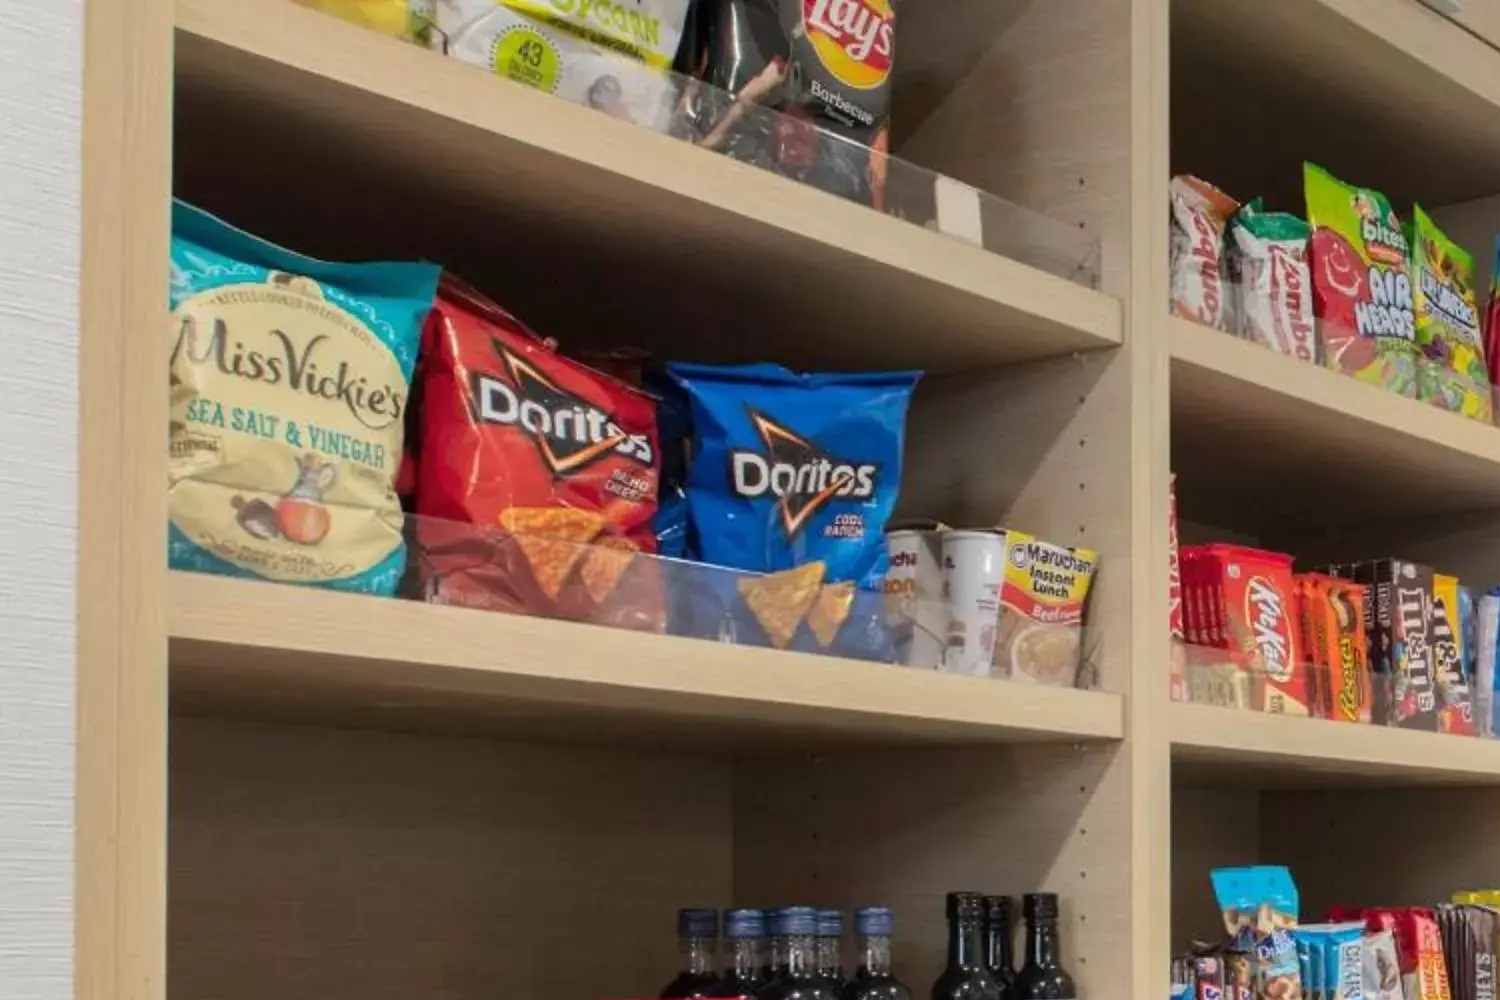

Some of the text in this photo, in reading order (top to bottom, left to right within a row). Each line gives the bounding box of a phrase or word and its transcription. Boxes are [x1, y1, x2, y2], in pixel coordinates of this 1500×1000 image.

[807, 0, 893, 60] Lay's
[518, 40, 545, 66] 43
[811, 80, 874, 126] Barbecue
[1368, 266, 1413, 308] AIR
[169, 315, 402, 431] Miss Vickie's
[186, 399, 386, 470] SEA SALT & VINEGAR
[480, 376, 653, 465] Doritos
[732, 452, 877, 497] Doritos
[1027, 543, 1095, 573] Maruchan
[1030, 567, 1076, 588] Instant
[1033, 583, 1069, 598] Lunch
